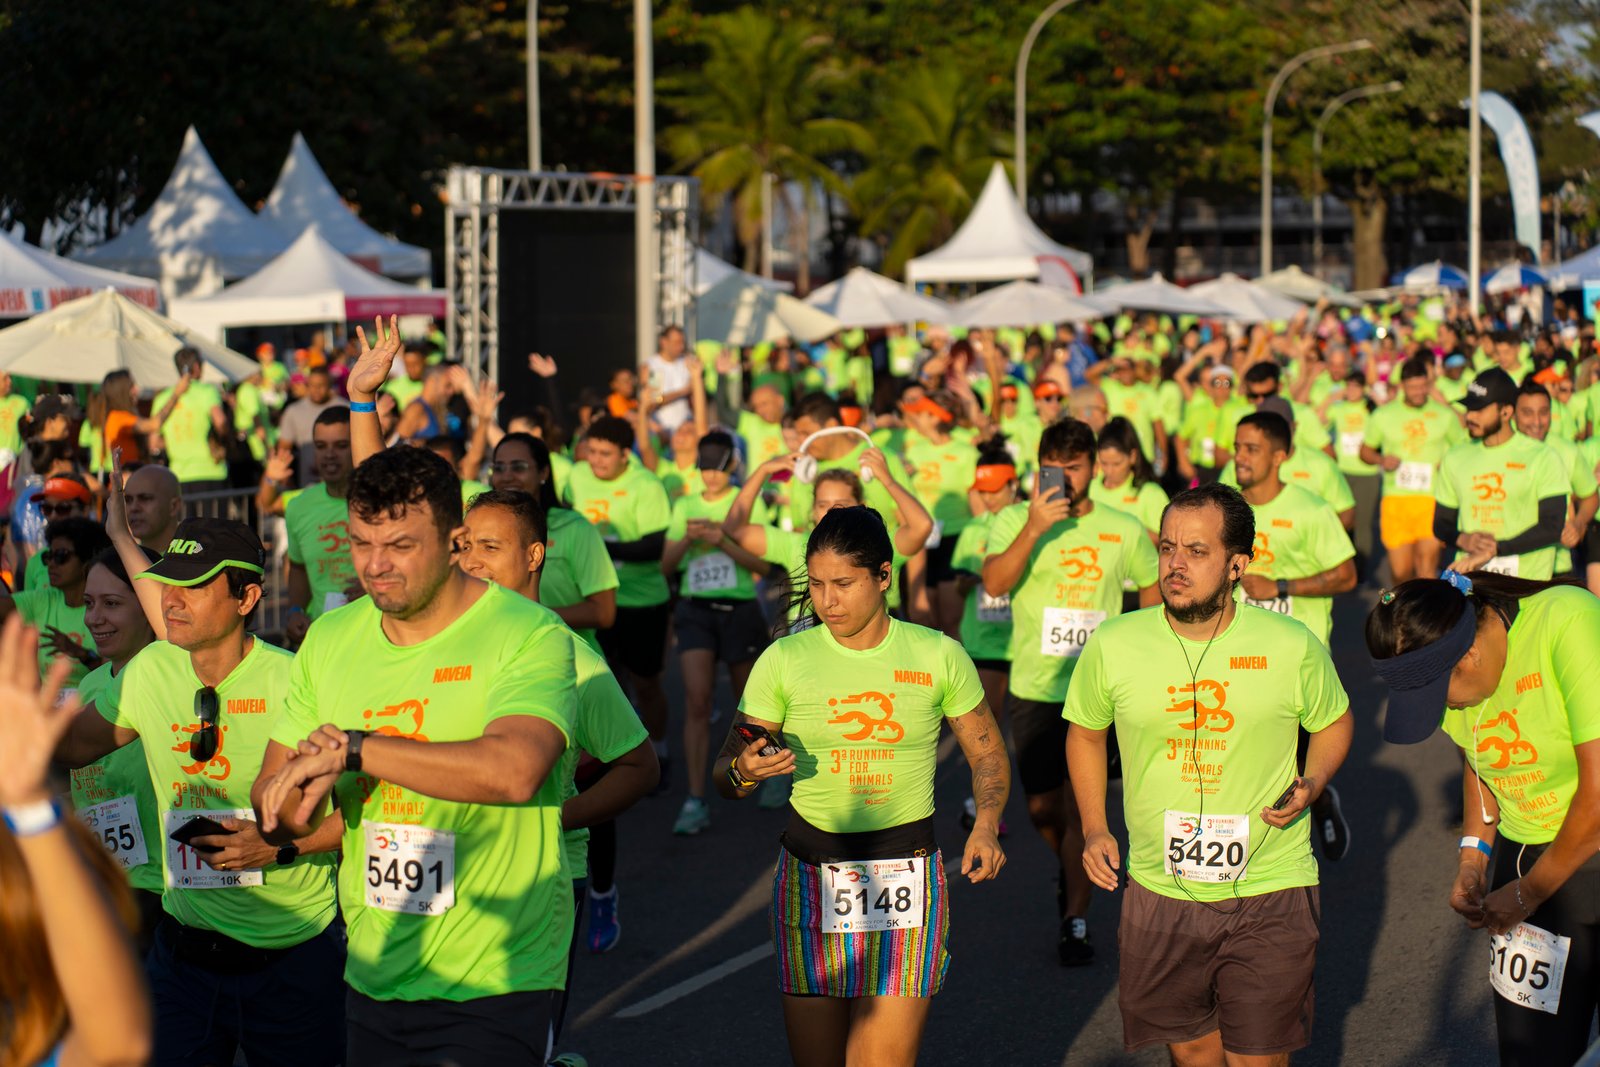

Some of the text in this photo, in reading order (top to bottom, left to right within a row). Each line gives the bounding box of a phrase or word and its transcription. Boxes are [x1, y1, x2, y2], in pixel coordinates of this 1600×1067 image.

[1230, 656, 1267, 669] NAVEIA
[433, 665, 472, 683] NAVEIA
[894, 670, 933, 687] NAVEIA
[227, 698, 266, 714] NAVEIA
[1185, 738, 1226, 751] RUNNING
[850, 749, 894, 760] RUNNING
[1184, 750, 1201, 762] FOR
[850, 762, 868, 773] FOR
[1182, 762, 1223, 776] ANIMALS
[850, 774, 892, 785] ANIMALS
[1506, 770, 1546, 787] RUNNING
[189, 784, 228, 800] RUNNING
[381, 787, 402, 800] FOR
[1510, 788, 1525, 800] FOR
[1517, 791, 1558, 812] ANIMALS
[383, 802, 425, 816] ANIMALS
[104, 823, 135, 854] 55
[1168, 837, 1243, 867] 5420
[220, 875, 242, 885] 10K
[368, 855, 443, 894] 5491
[1218, 873, 1231, 881] 5K
[418, 901, 433, 912] 5K
[834, 886, 911, 916] 5148
[886, 919, 900, 928] 5K
[1517, 991, 1532, 1004] 5K
